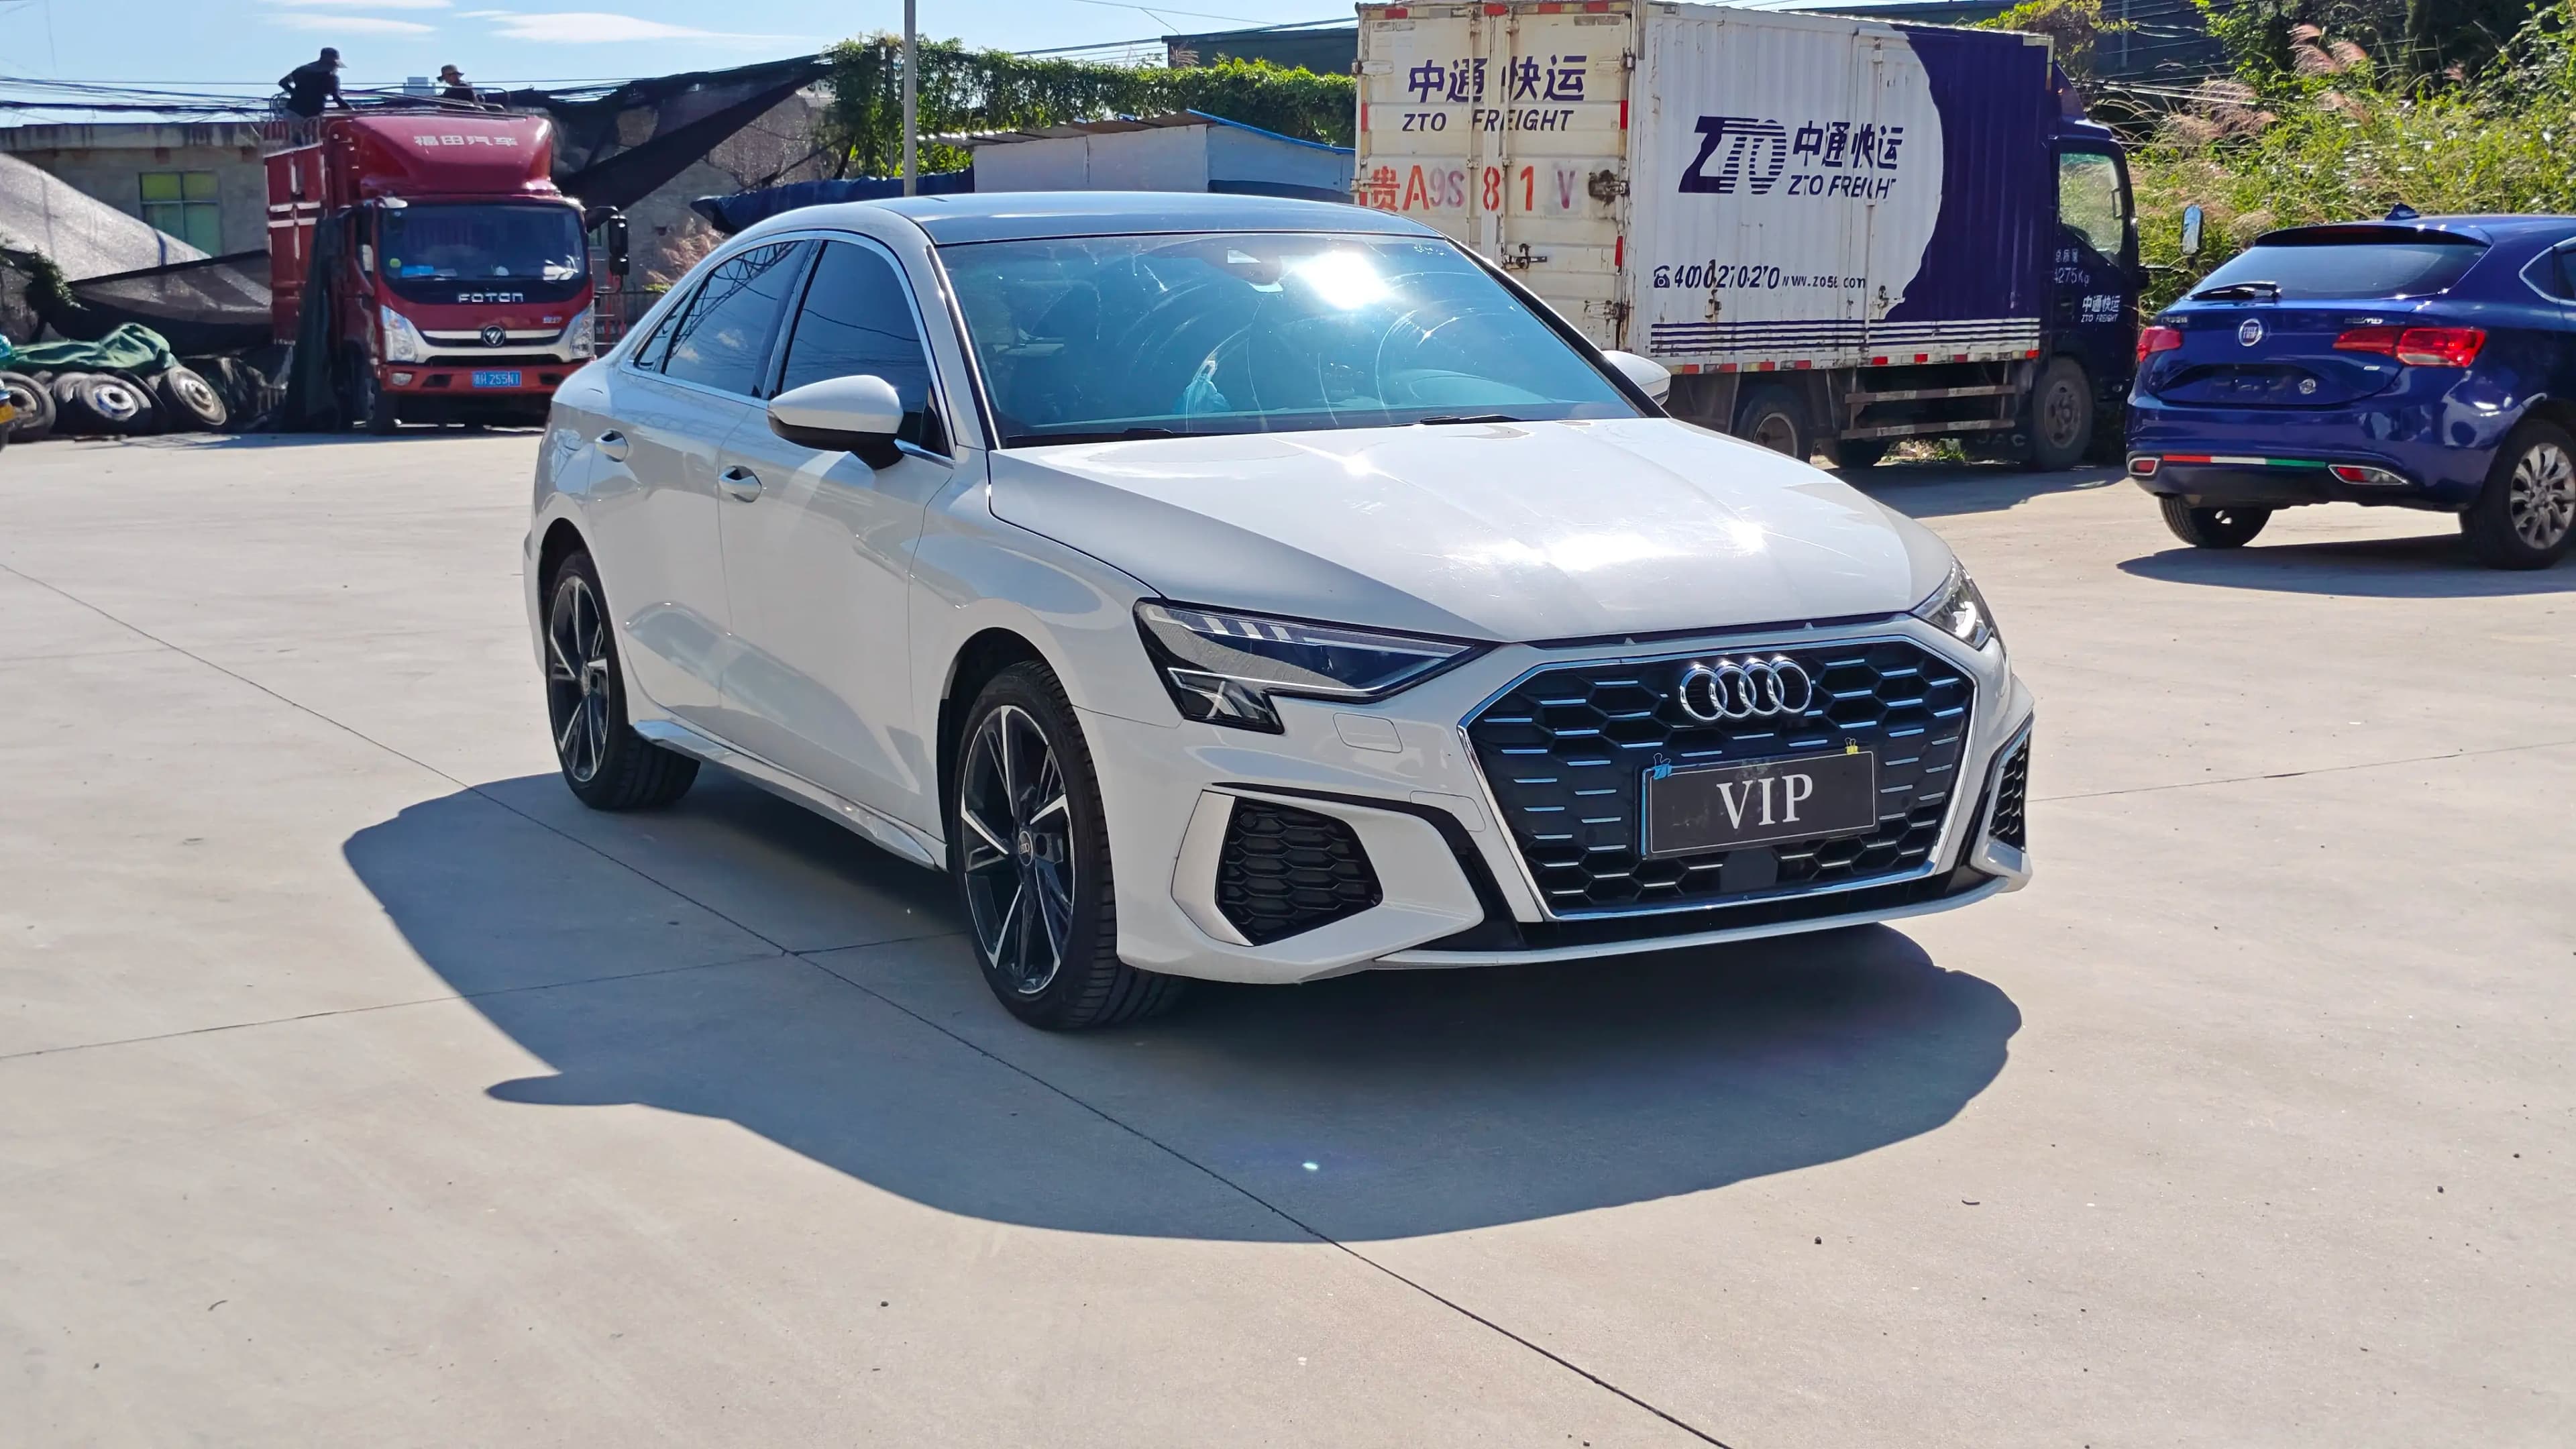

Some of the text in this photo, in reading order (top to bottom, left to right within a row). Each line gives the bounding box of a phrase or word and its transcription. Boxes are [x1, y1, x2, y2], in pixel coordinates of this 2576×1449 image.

[1407, 54, 1587, 103] 中通快运
[1401, 109, 1574, 132] ZTO FREIGHT
[413, 136, 519, 146] 福田汽车
[1792, 120, 1904, 170] 中通快运
[1678, 115, 1787, 195] ZTO
[1787, 174, 1823, 196] ZTO
[458, 292, 524, 303] FOTON
[2082, 294, 2121, 313] 中通快运
[2080, 314, 2094, 322] ZTO
[1716, 773, 1813, 830] VIP
